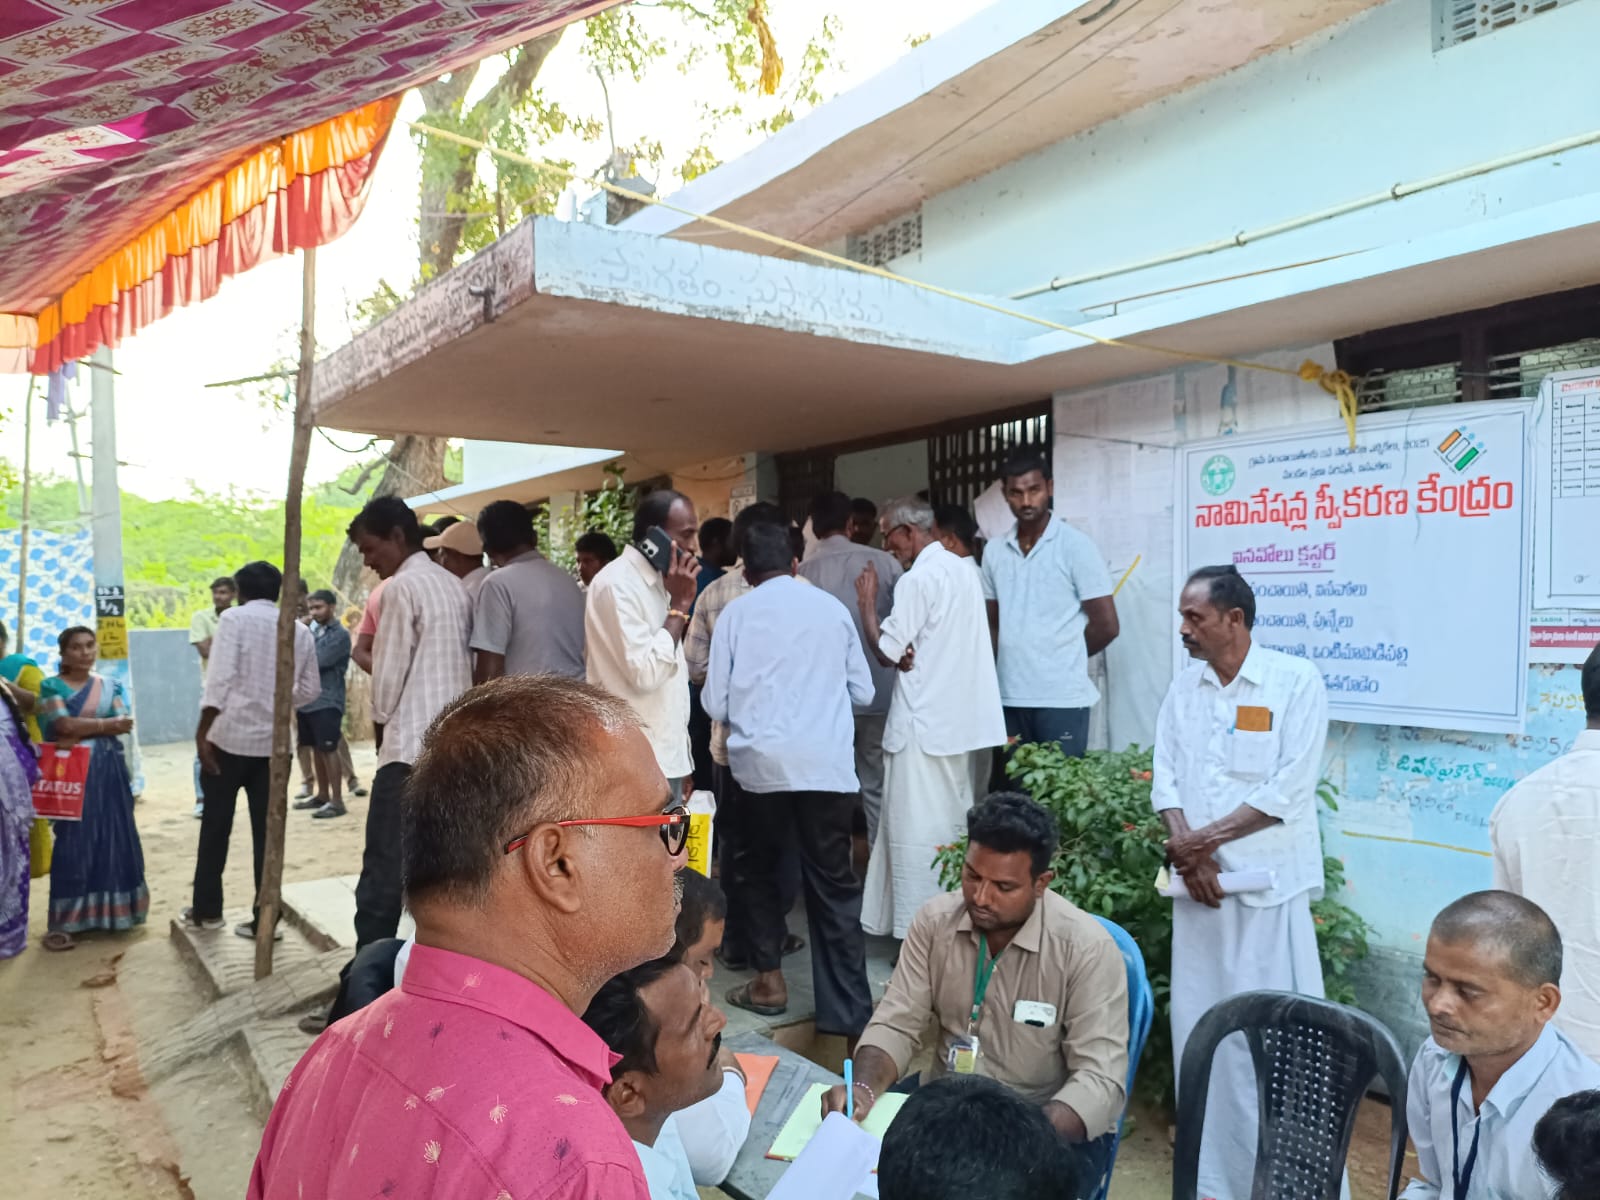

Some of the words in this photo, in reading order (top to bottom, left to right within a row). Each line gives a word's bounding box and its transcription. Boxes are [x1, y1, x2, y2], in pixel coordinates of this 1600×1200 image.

[1195, 487, 1308, 531] నామినేషన్ల
[1315, 484, 1408, 529] స్వీకరణ
[1417, 472, 1514, 518] కేంద్రం
[33, 779, 82, 794] TATUS
